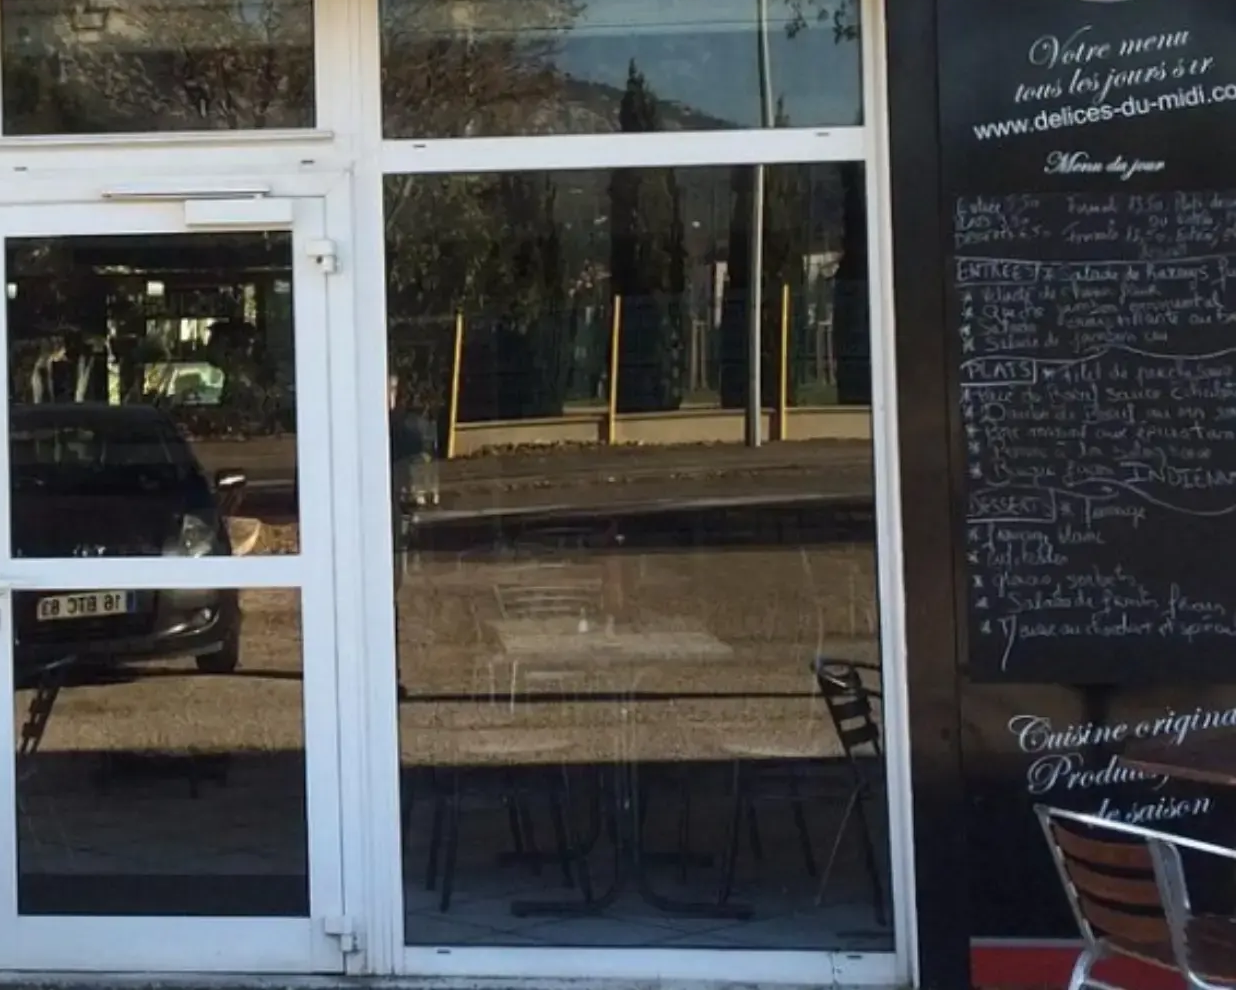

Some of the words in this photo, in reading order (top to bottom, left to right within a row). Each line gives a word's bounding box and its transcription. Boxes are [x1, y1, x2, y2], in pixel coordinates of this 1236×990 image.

[1028, 24, 1112, 70] Votre
[1118, 28, 1190, 57] menu
[1014, 78, 1063, 103] tous
[1067, 67, 1101, 95] les
[1093, 60, 1167, 105] jours
[1043, 150, 1104, 175] Menu
[1105, 155, 1128, 174] du
[1121, 158, 1165, 181] jour
[1008, 713, 1128, 754] Cuisine
[1124, 795, 1215, 824] saison
